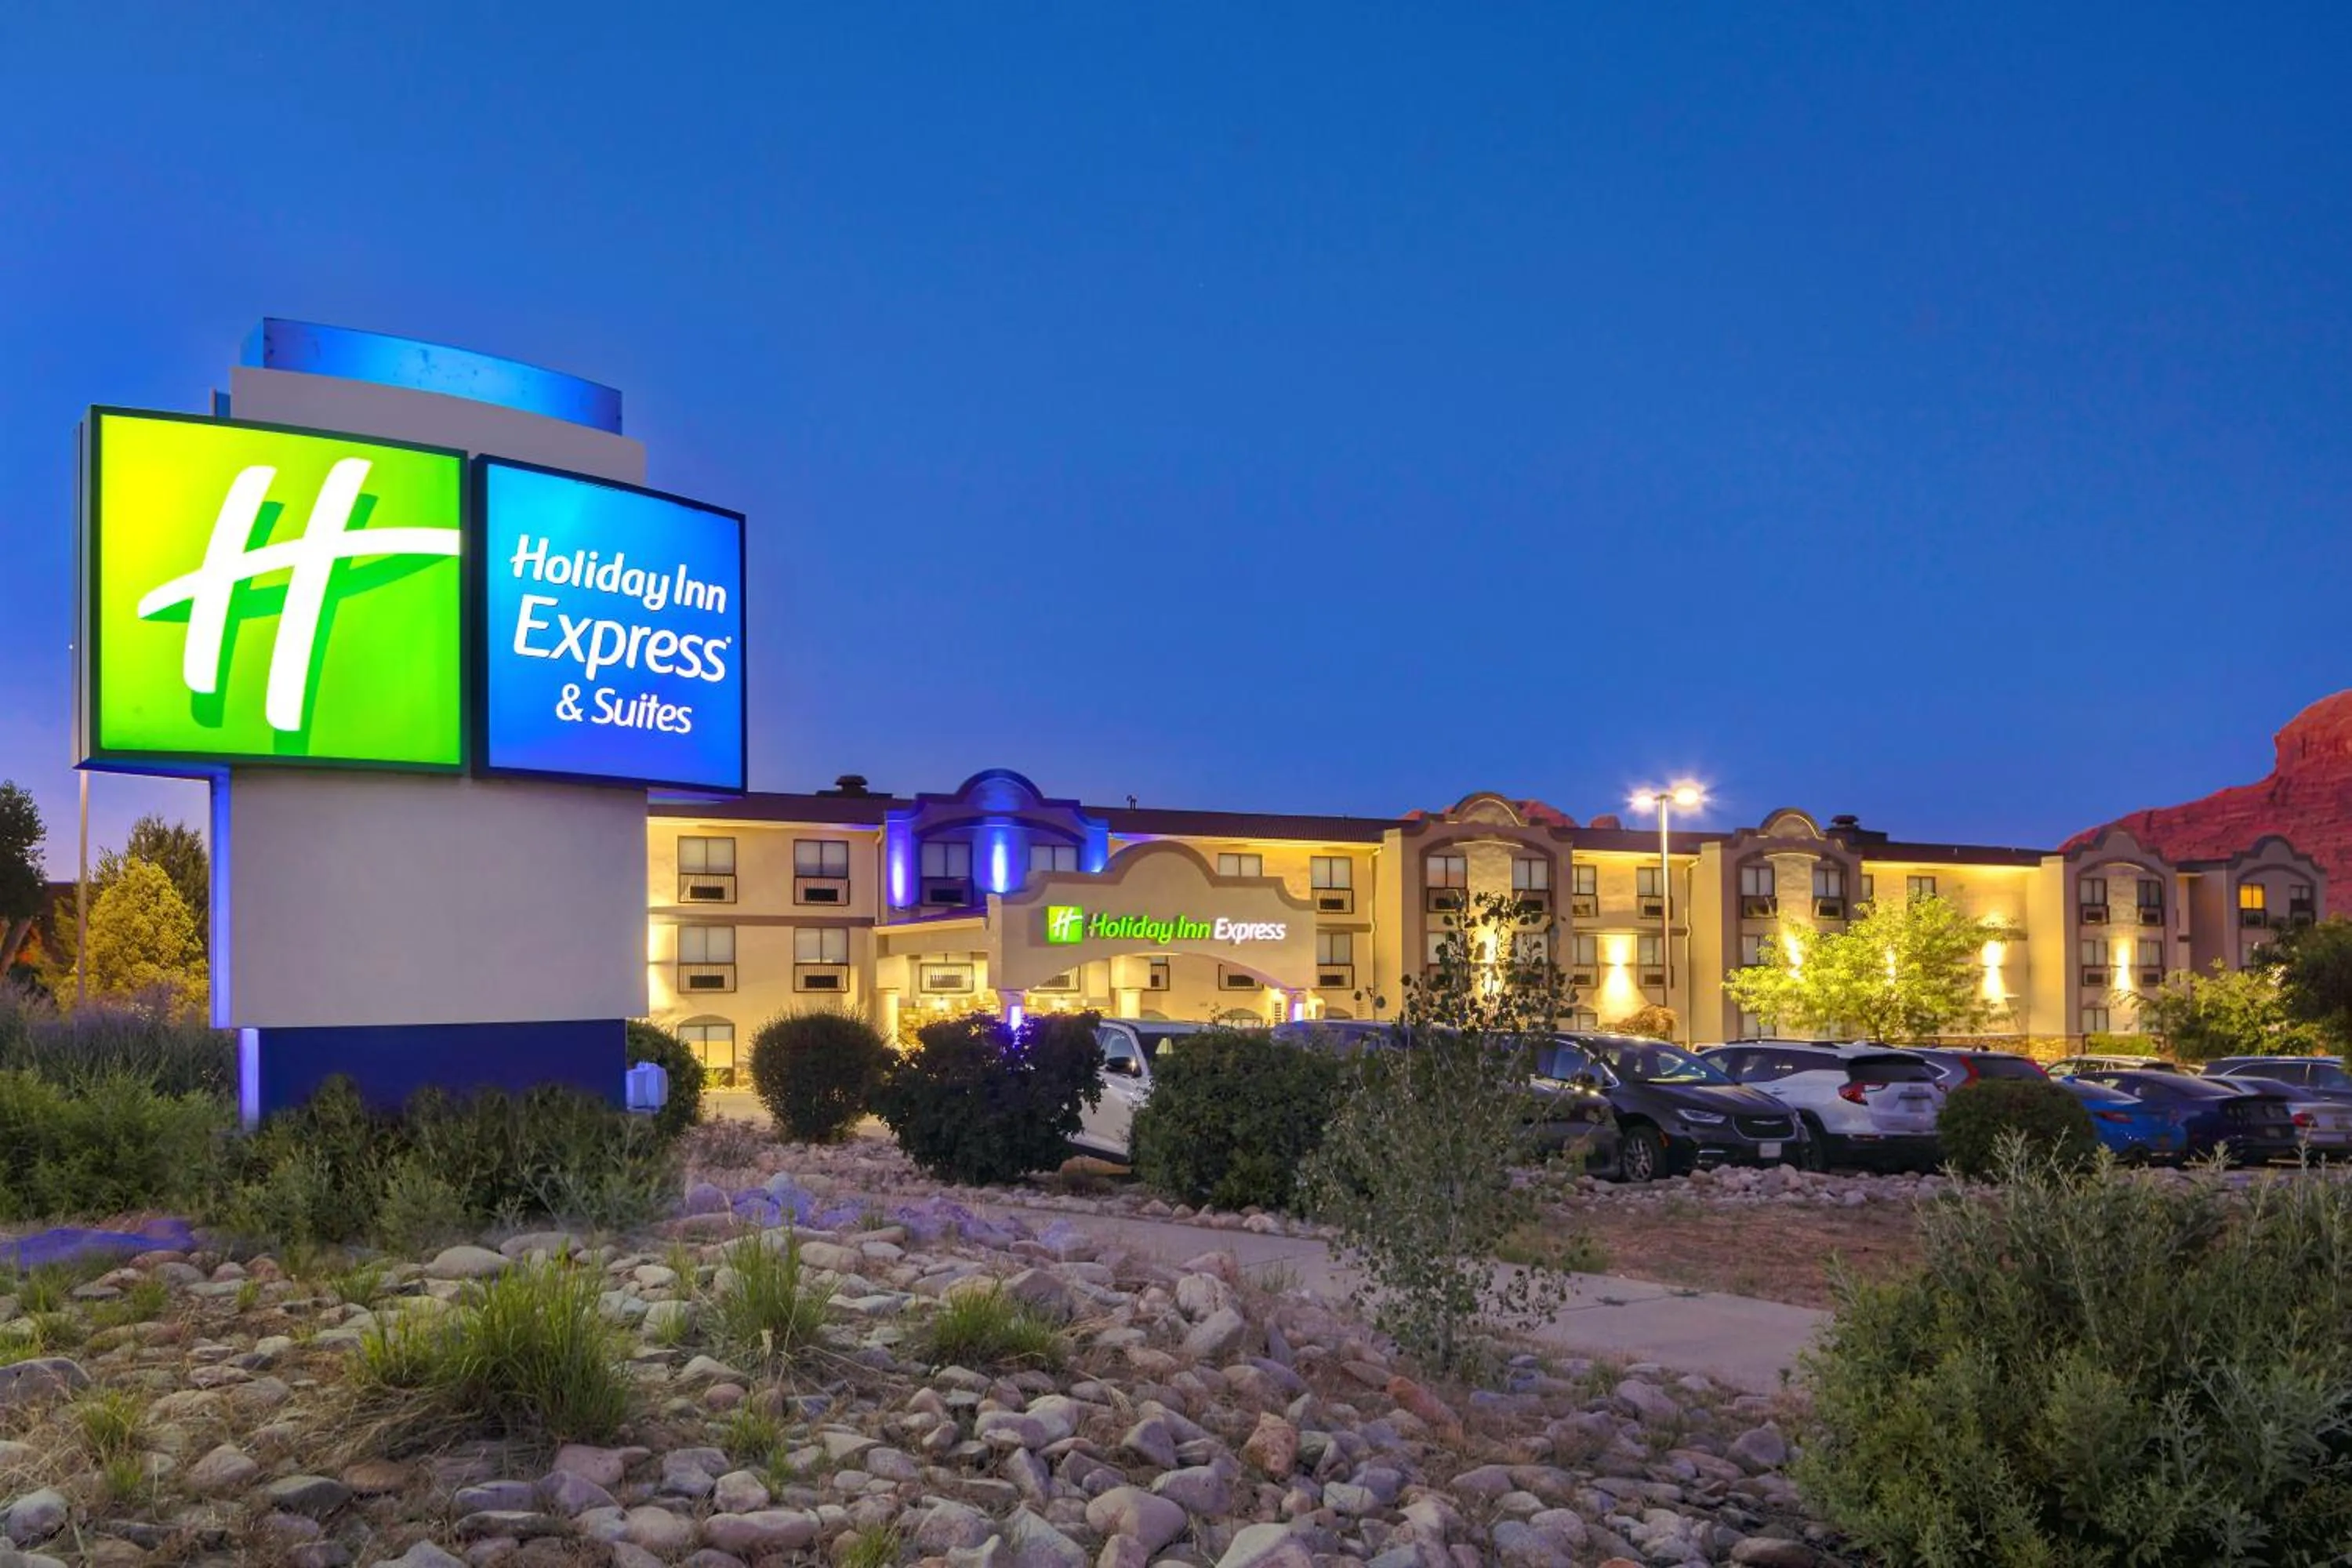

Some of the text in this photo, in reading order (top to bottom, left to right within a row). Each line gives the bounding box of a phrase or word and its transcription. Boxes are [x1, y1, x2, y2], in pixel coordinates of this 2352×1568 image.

[510, 534, 727, 614] Holiday Inn
[514, 593, 728, 682] Express
[555, 683, 692, 734] & Suites
[1087, 913, 1287, 946] Holiday Inn Express
